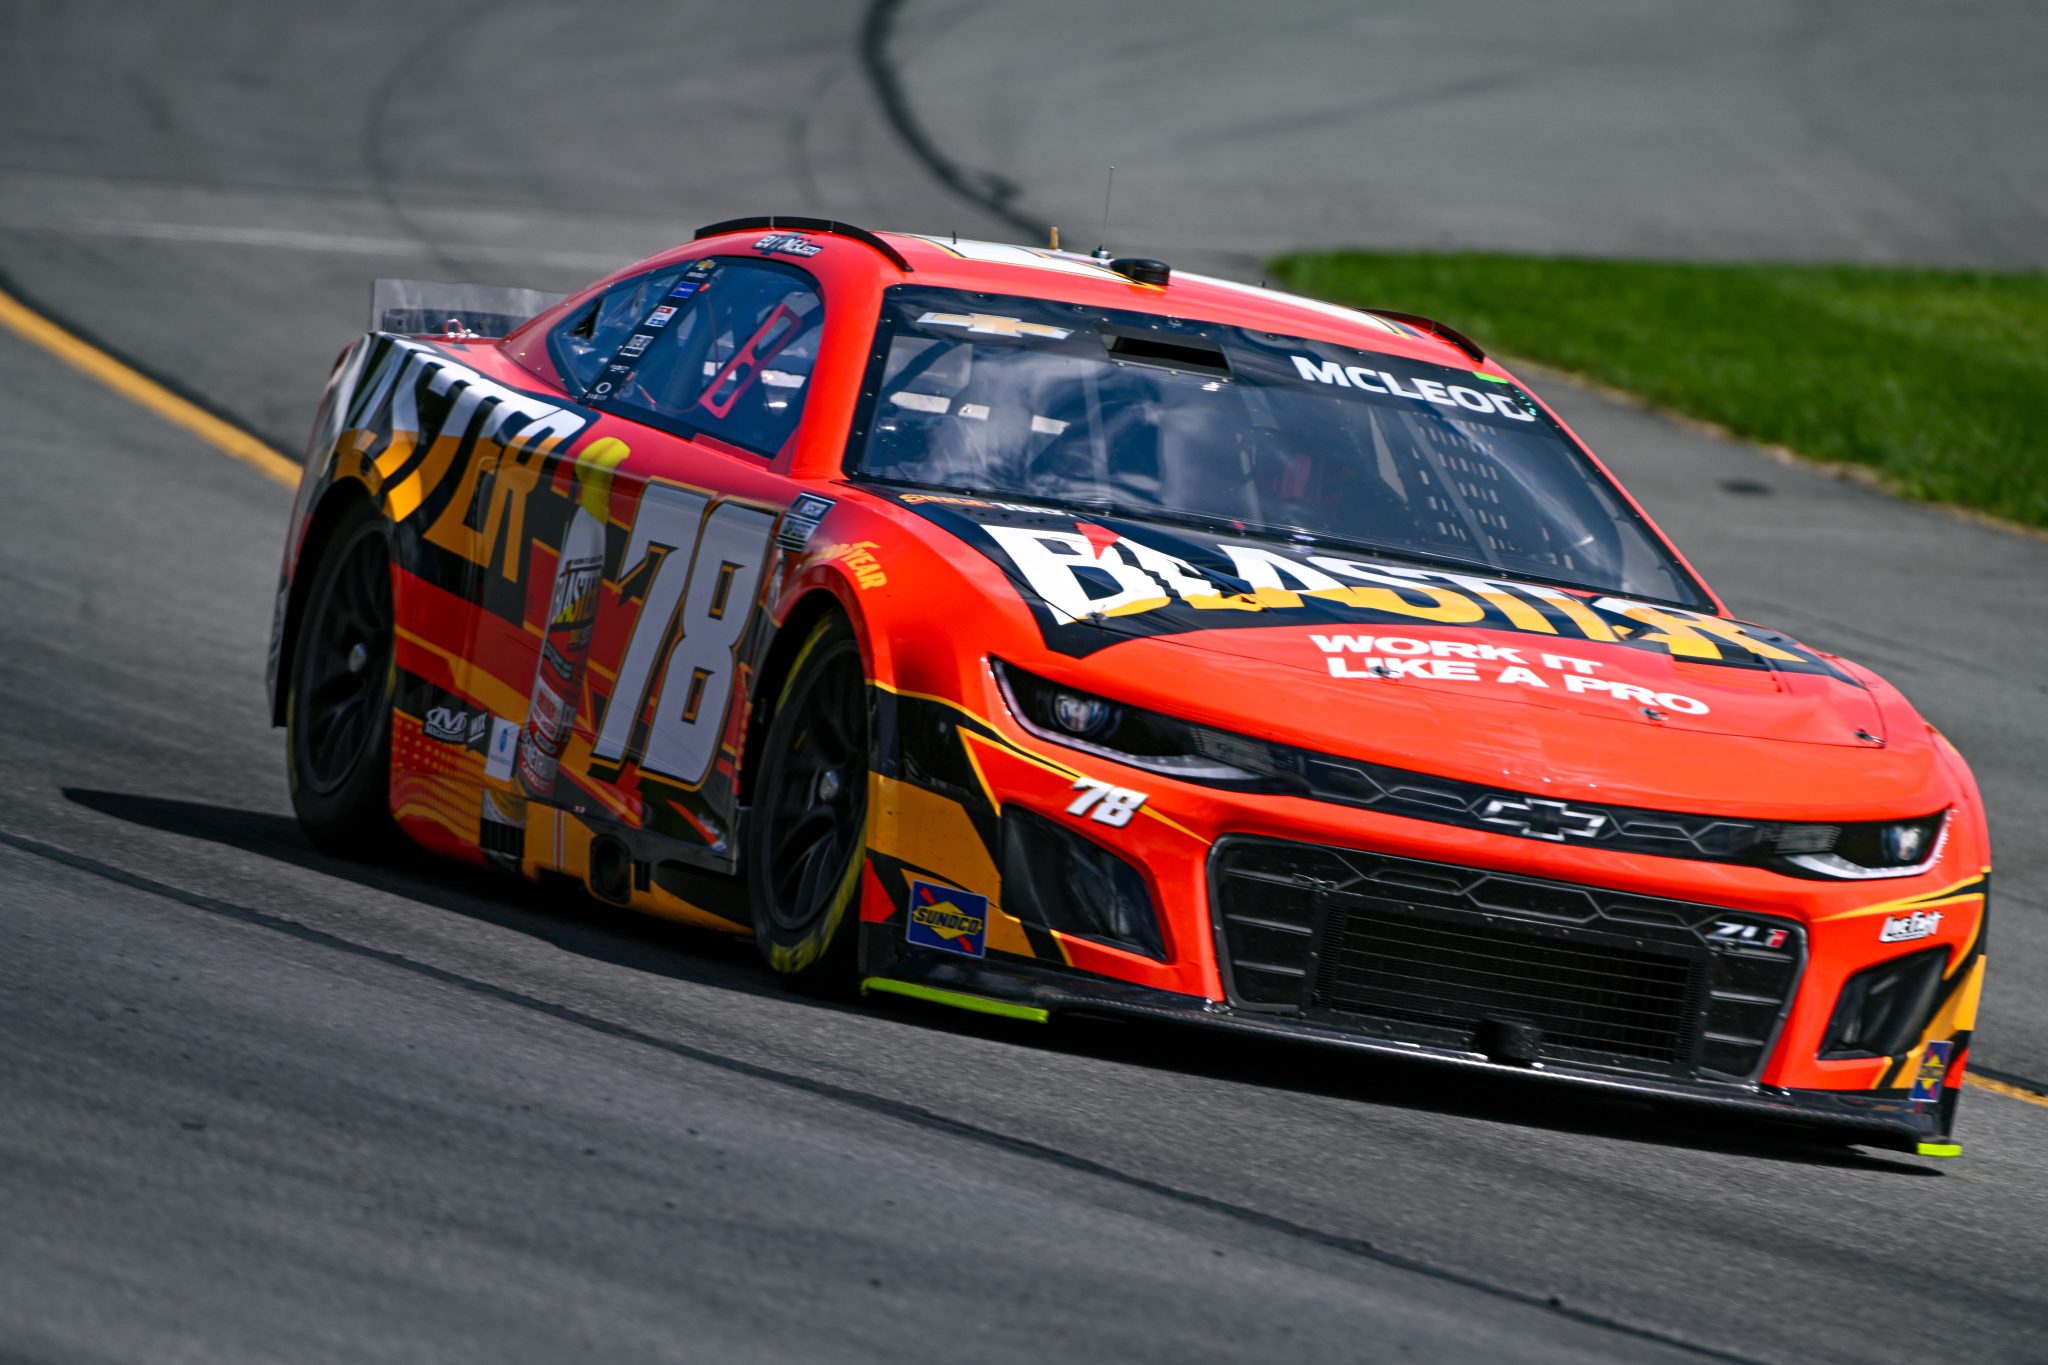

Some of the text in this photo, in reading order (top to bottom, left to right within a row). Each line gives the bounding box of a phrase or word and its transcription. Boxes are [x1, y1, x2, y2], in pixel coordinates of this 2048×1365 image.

[1290, 355, 1536, 423] MCLEOD
[591, 477, 780, 789] 78
[1309, 634, 1603, 675] WORK IT
[1327, 656, 1711, 716] LIKE A PRO
[1066, 776, 1151, 829] 78
[913, 905, 983, 935] SUNOCO
